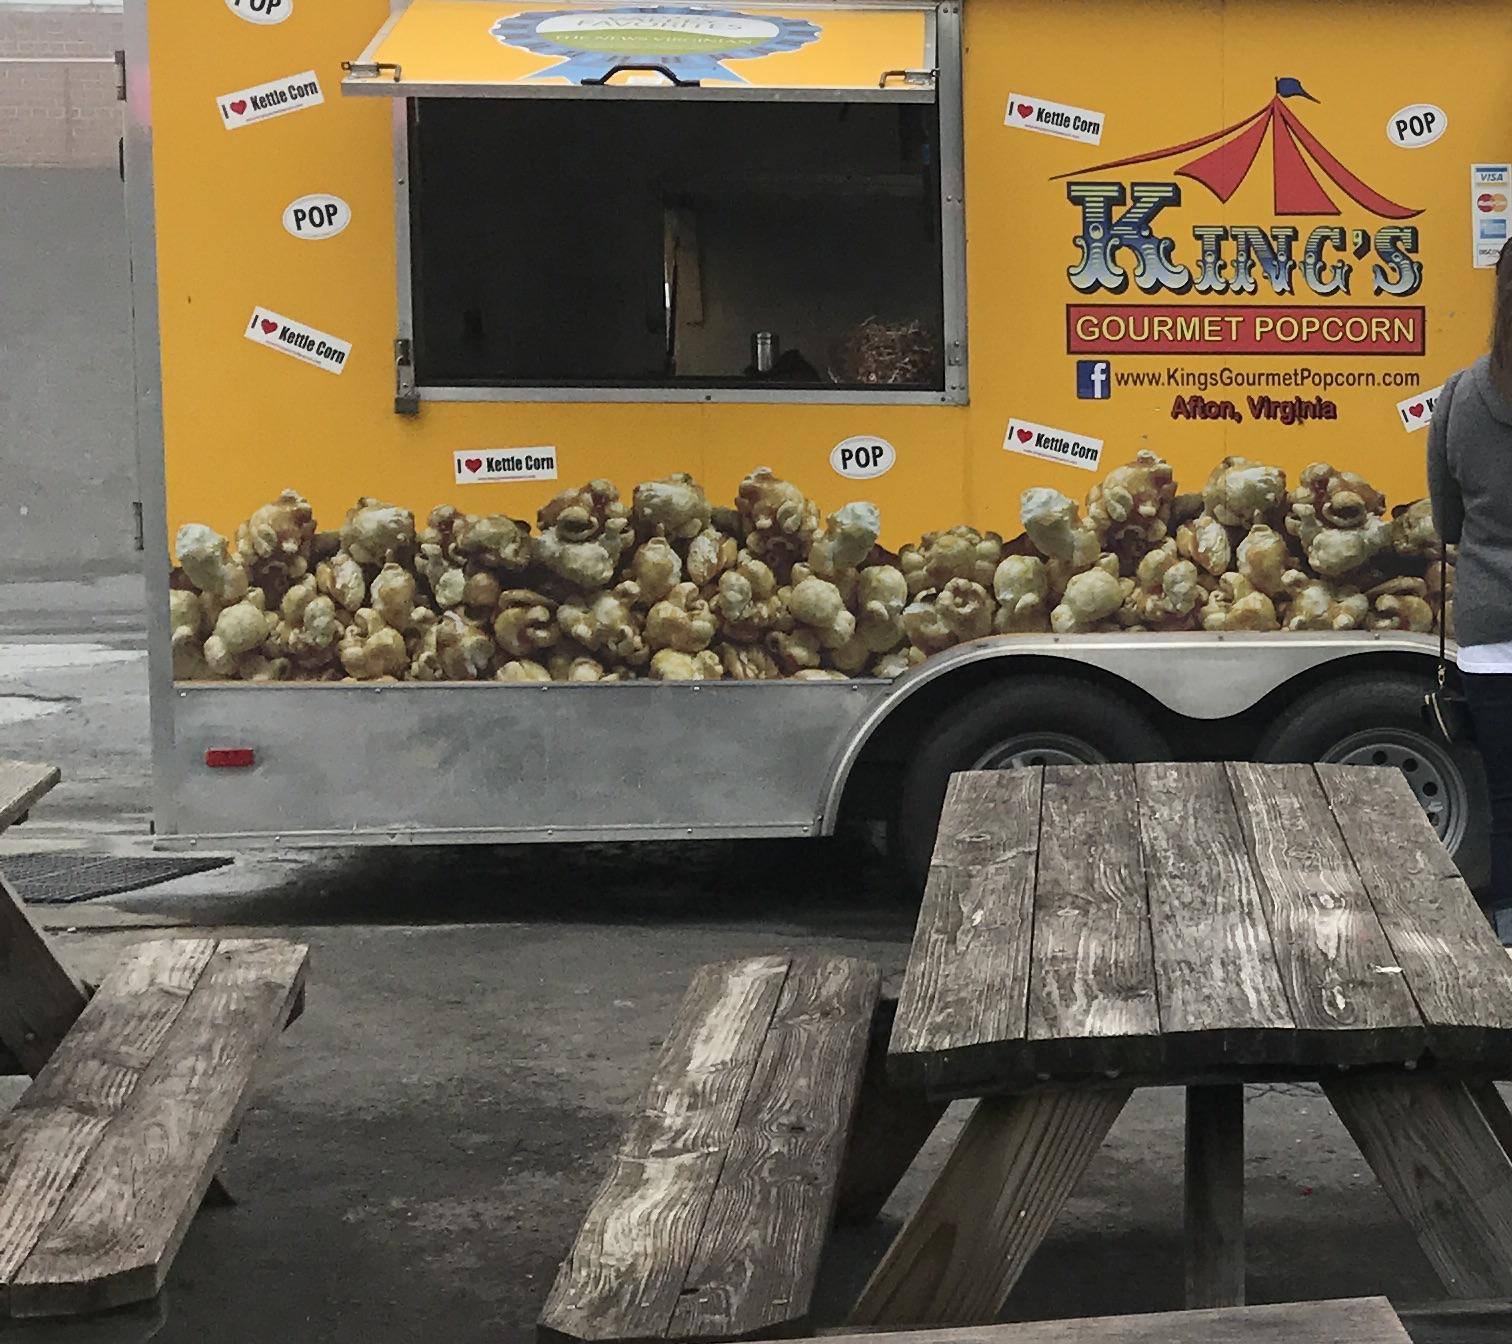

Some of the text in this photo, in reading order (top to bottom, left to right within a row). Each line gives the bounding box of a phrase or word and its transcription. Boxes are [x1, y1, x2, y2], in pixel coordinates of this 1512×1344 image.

[222, 105, 230, 119] I
[250, 89, 288, 111] Kettle
[288, 81, 318, 101] Corn
[1008, 101, 1014, 116] I
[1036, 107, 1071, 128] Kettle
[1072, 115, 1101, 135] Corn
[1396, 111, 1436, 141] POP
[1481, 173, 1504, 181] VISA
[293, 204, 338, 231] POP
[1067, 181, 1424, 298] KING'S
[251, 314, 259, 329] I
[279, 325, 315, 353] Kettle
[315, 341, 346, 364] Corn
[1076, 316, 1415, 342] GOURMET POPCORN
[1115, 367, 1420, 392] www.KingsGourmetPopcorn.com
[1171, 394, 1338, 425] Afton, Virginia
[840, 445, 884, 470] POP
[1035, 432, 1070, 455] Kettle
[1070, 441, 1099, 462] Corn
[486, 456, 523, 472] Kettle
[525, 455, 554, 470] Corn
